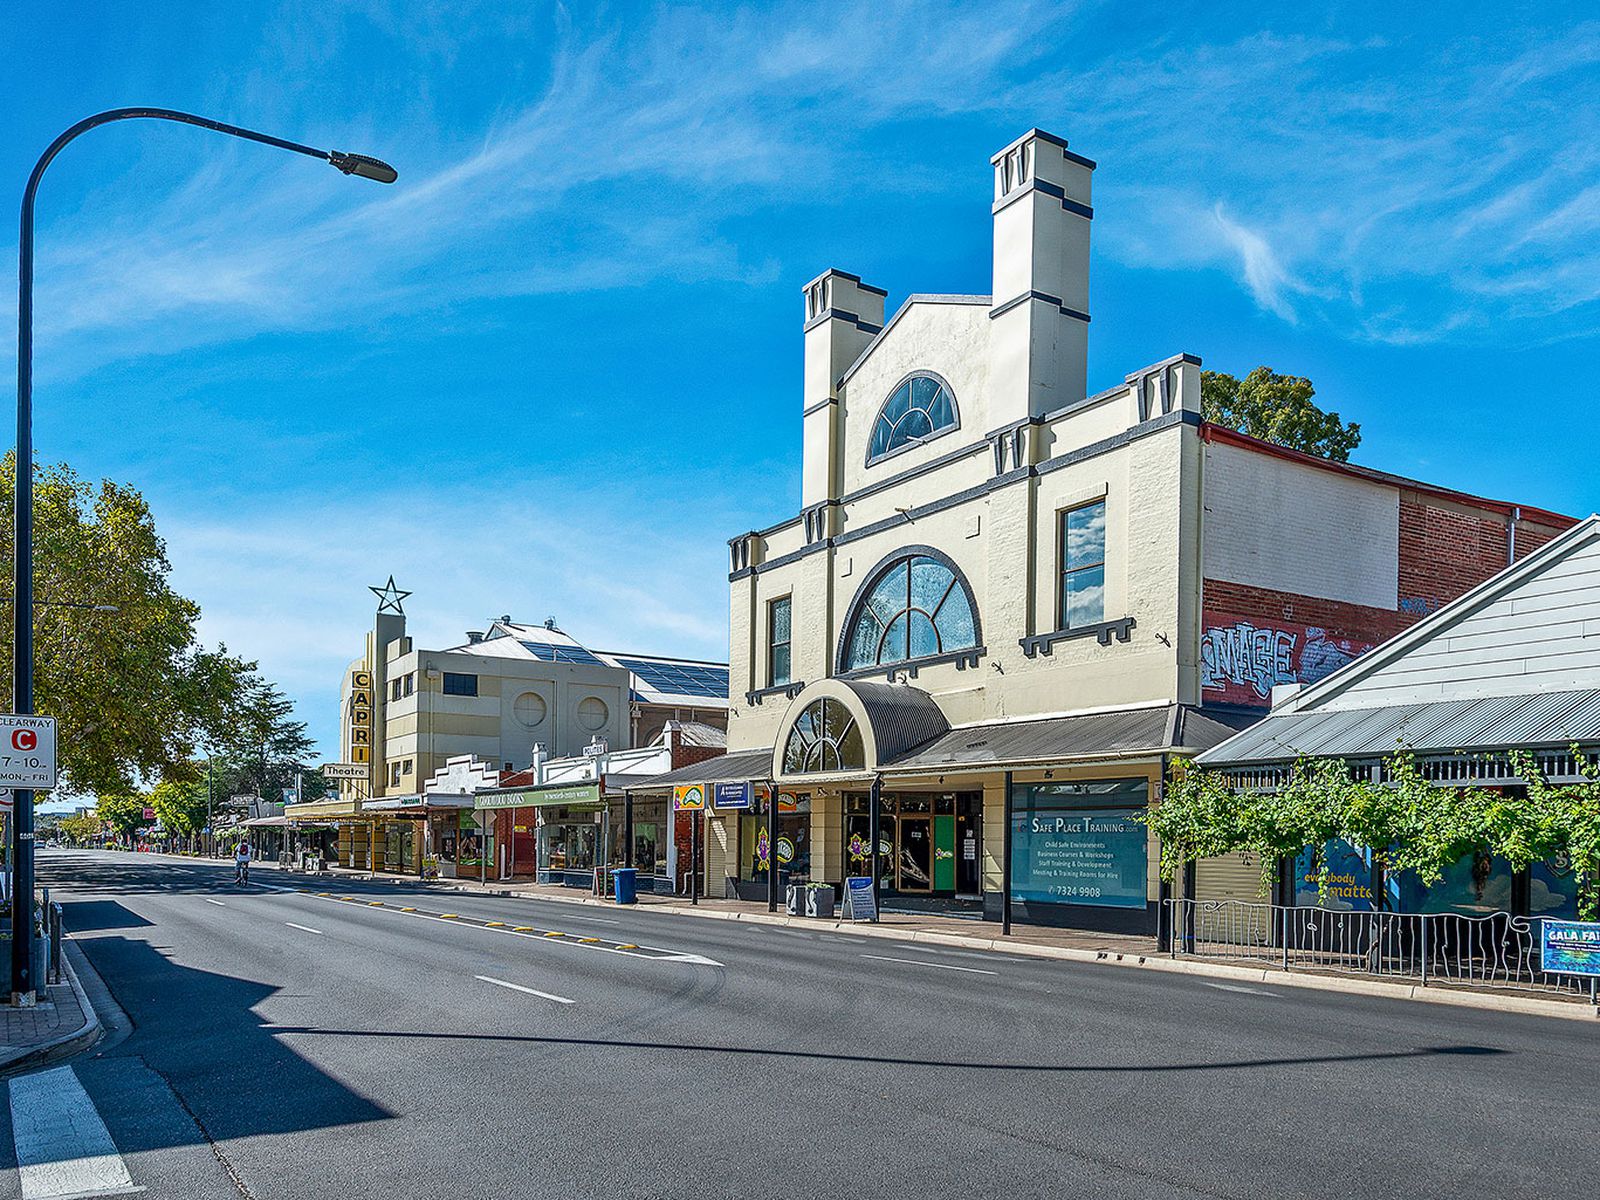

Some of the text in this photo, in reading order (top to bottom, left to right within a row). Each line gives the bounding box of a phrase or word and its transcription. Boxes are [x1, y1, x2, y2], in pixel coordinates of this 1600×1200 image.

[355, 673, 368, 761] CAPRI
[17, 731, 31, 749] C
[327, 767, 364, 776] Theatre
[1032, 817, 1052, 833] SAFE
[1055, 817, 1081, 833] PLACE
[1070, 841, 1106, 849] Environments
[1051, 861, 1071, 869] Training
[1077, 861, 1112, 869] Development
[1058, 870, 1079, 878] Training
[1304, 872, 1356, 886] eveybody
[1056, 885, 1101, 898] 7324 9908
[1329, 885, 1388, 899] mattes
[1548, 930, 1579, 941] GALA
